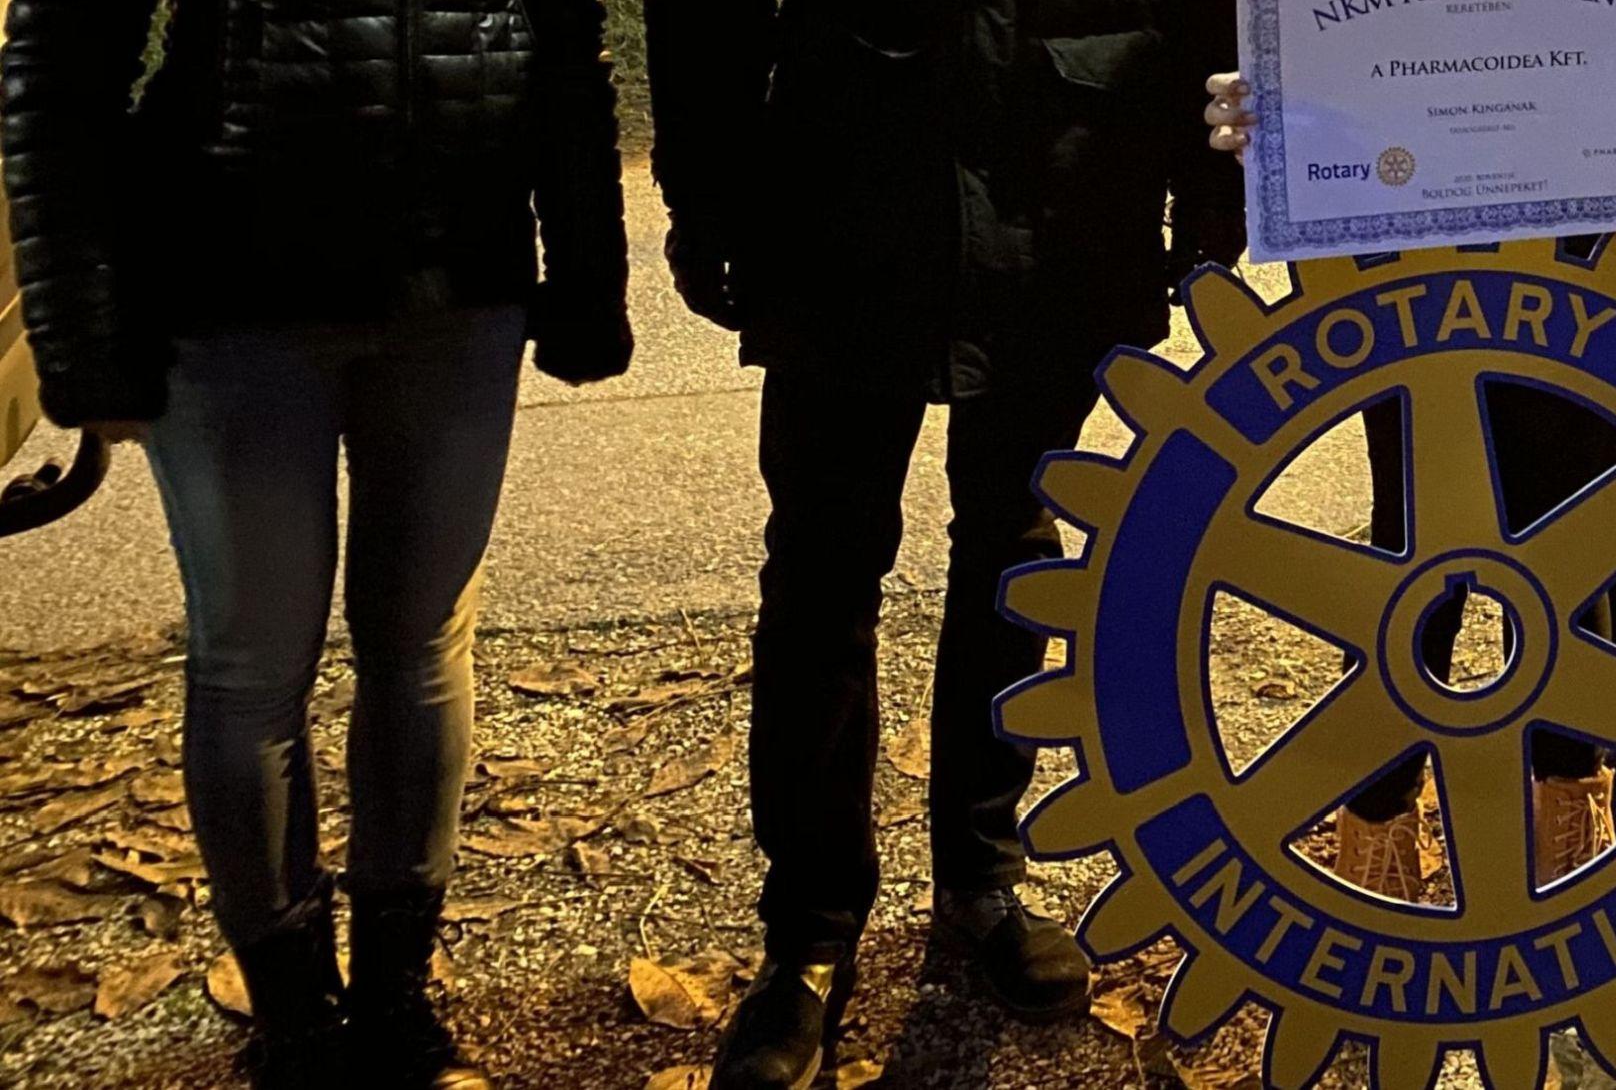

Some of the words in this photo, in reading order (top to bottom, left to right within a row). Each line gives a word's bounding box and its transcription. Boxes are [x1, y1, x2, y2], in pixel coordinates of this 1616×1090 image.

[1370, 63, 1384, 78] A
[1390, 53, 1544, 77] PHARMACOIDEA
[1427, 106, 1468, 117] SIMON
[1307, 160, 1371, 182] Rotary
